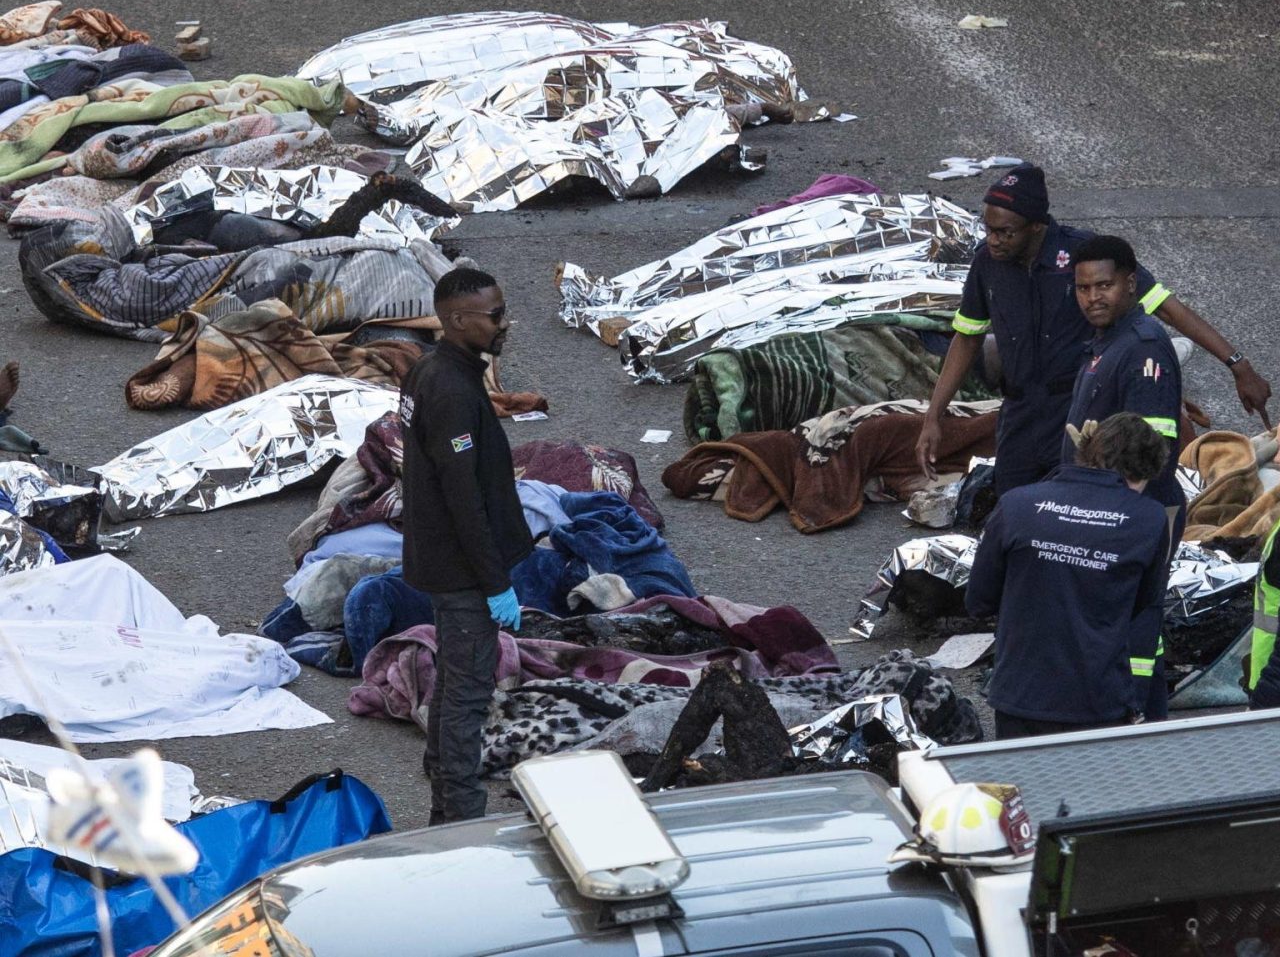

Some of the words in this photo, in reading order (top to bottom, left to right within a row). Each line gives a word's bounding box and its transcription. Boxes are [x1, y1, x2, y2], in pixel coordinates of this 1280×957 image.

[1043, 501, 1071, 516] Medi
[1069, 505, 1120, 521] Response
[1031, 539, 1090, 557] EMERGENCY
[1093, 550, 1119, 563] CARE
[1038, 550, 1108, 571] PRACTITIONER
